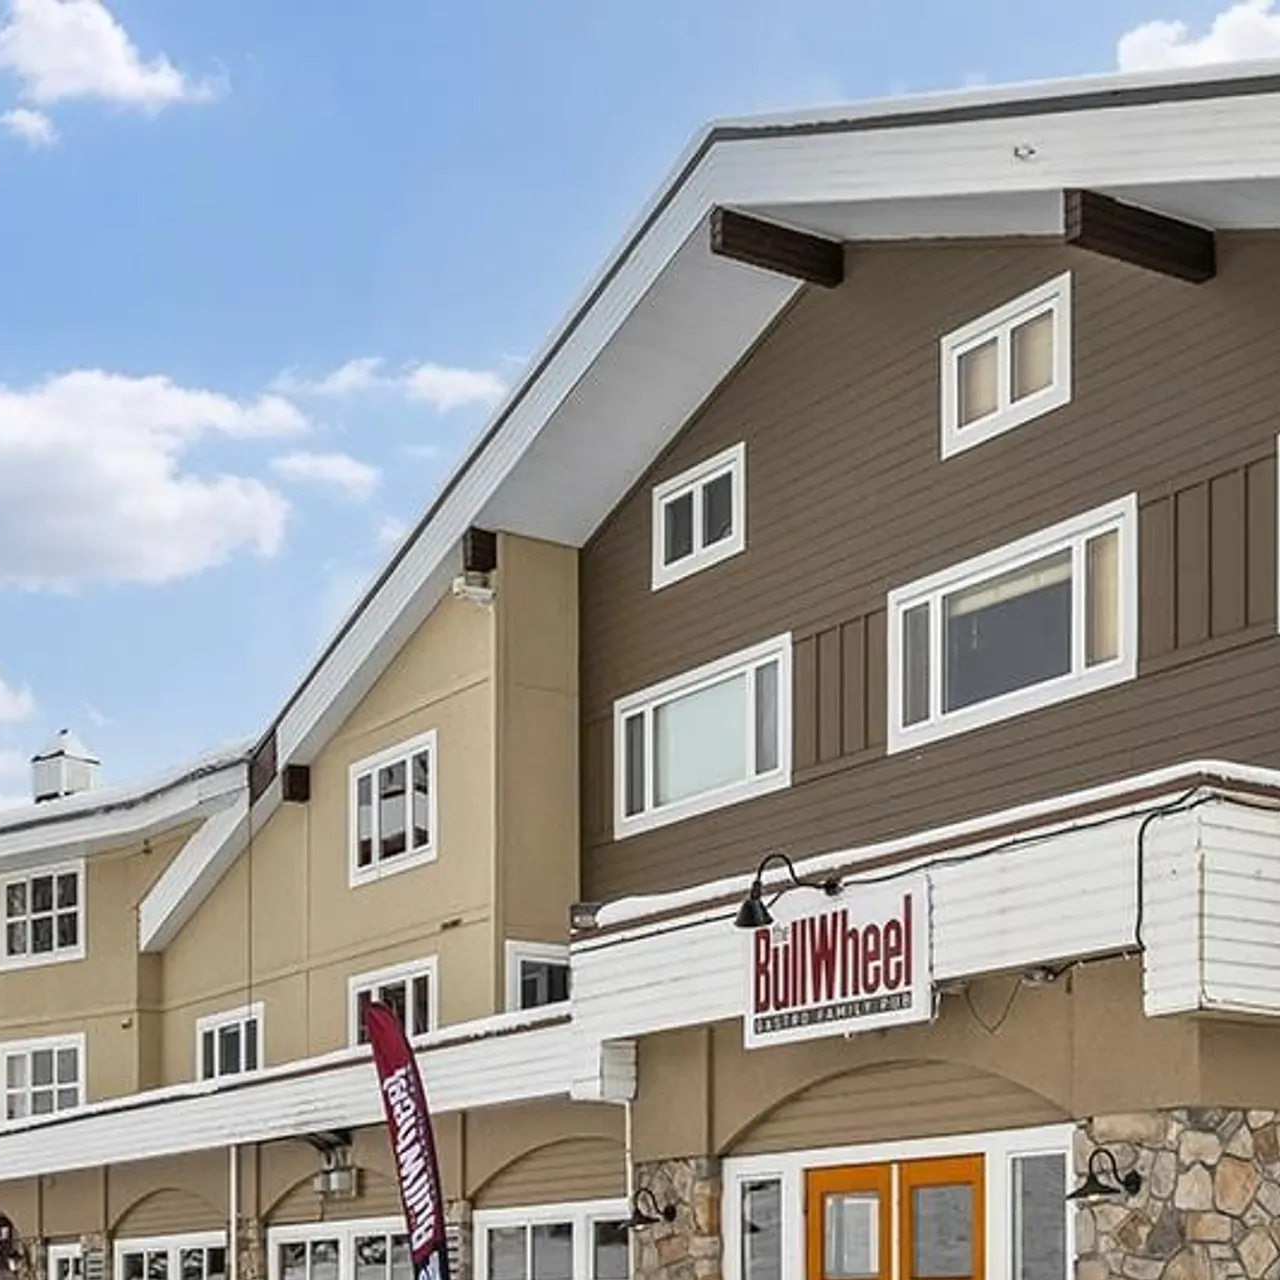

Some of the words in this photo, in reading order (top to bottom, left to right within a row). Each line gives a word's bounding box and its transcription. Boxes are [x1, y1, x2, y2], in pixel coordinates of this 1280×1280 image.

[754, 893, 913, 1014] BullWheel
[817, 1002, 872, 1020] FAMILY
[878, 992, 912, 1009] PUB
